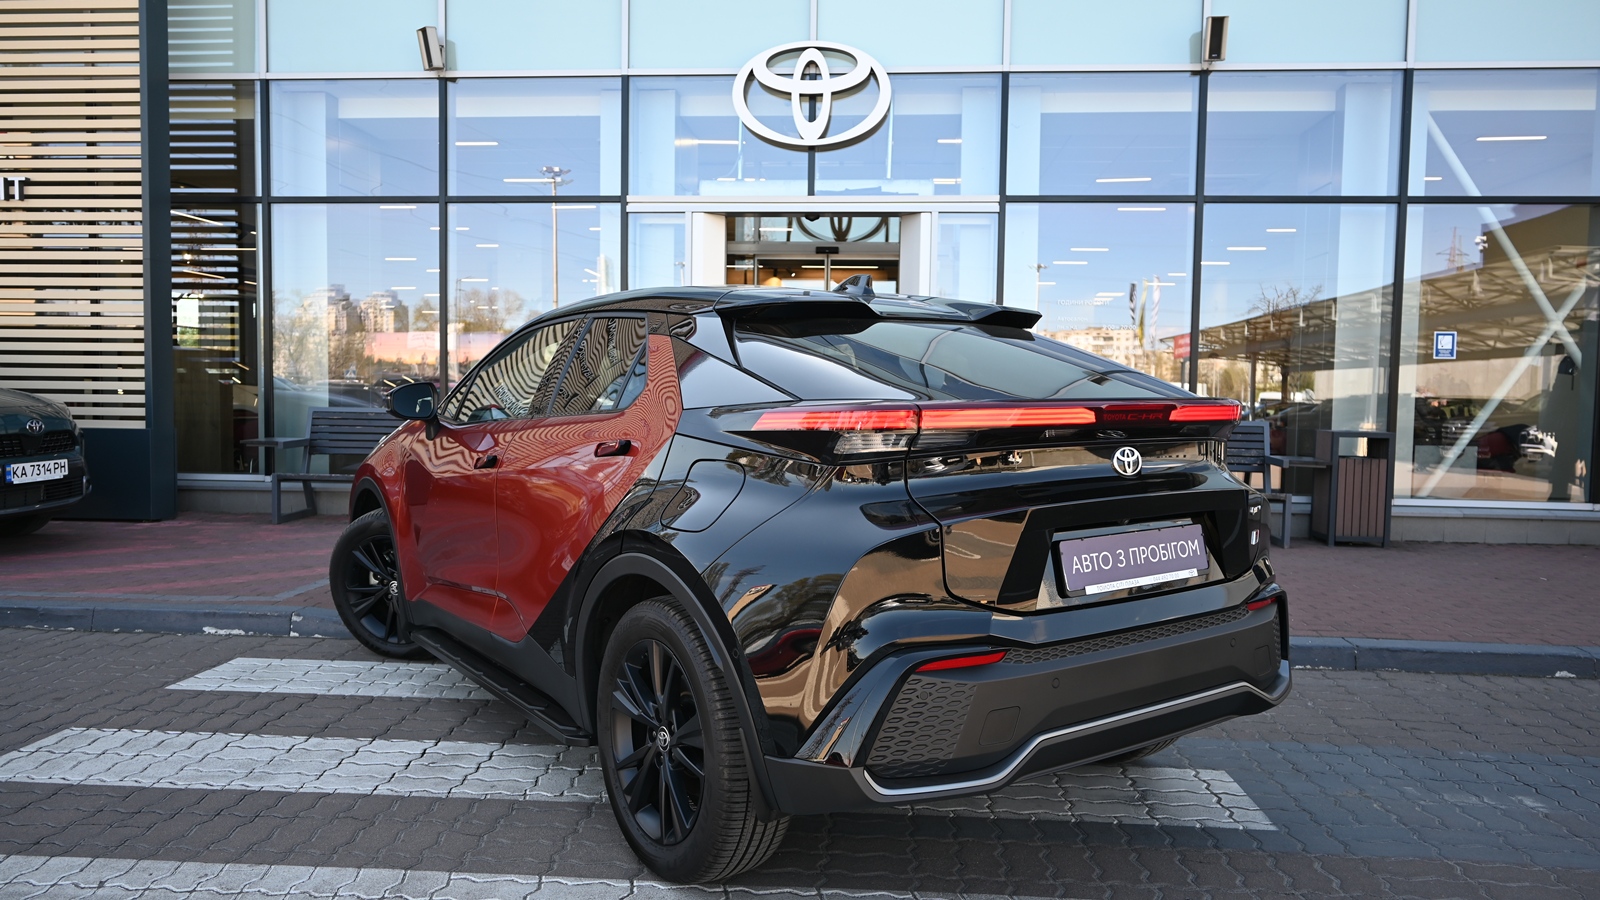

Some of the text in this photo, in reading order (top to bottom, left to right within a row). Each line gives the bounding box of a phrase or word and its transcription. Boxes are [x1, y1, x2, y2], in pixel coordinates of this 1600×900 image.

[12, 465, 28, 479] KA
[30, 463, 52, 477] 7314
[53, 462, 66, 474] PH
[1072, 551, 1113, 574] АВТО
[1129, 539, 1201, 566] ПРОБІГОМ
